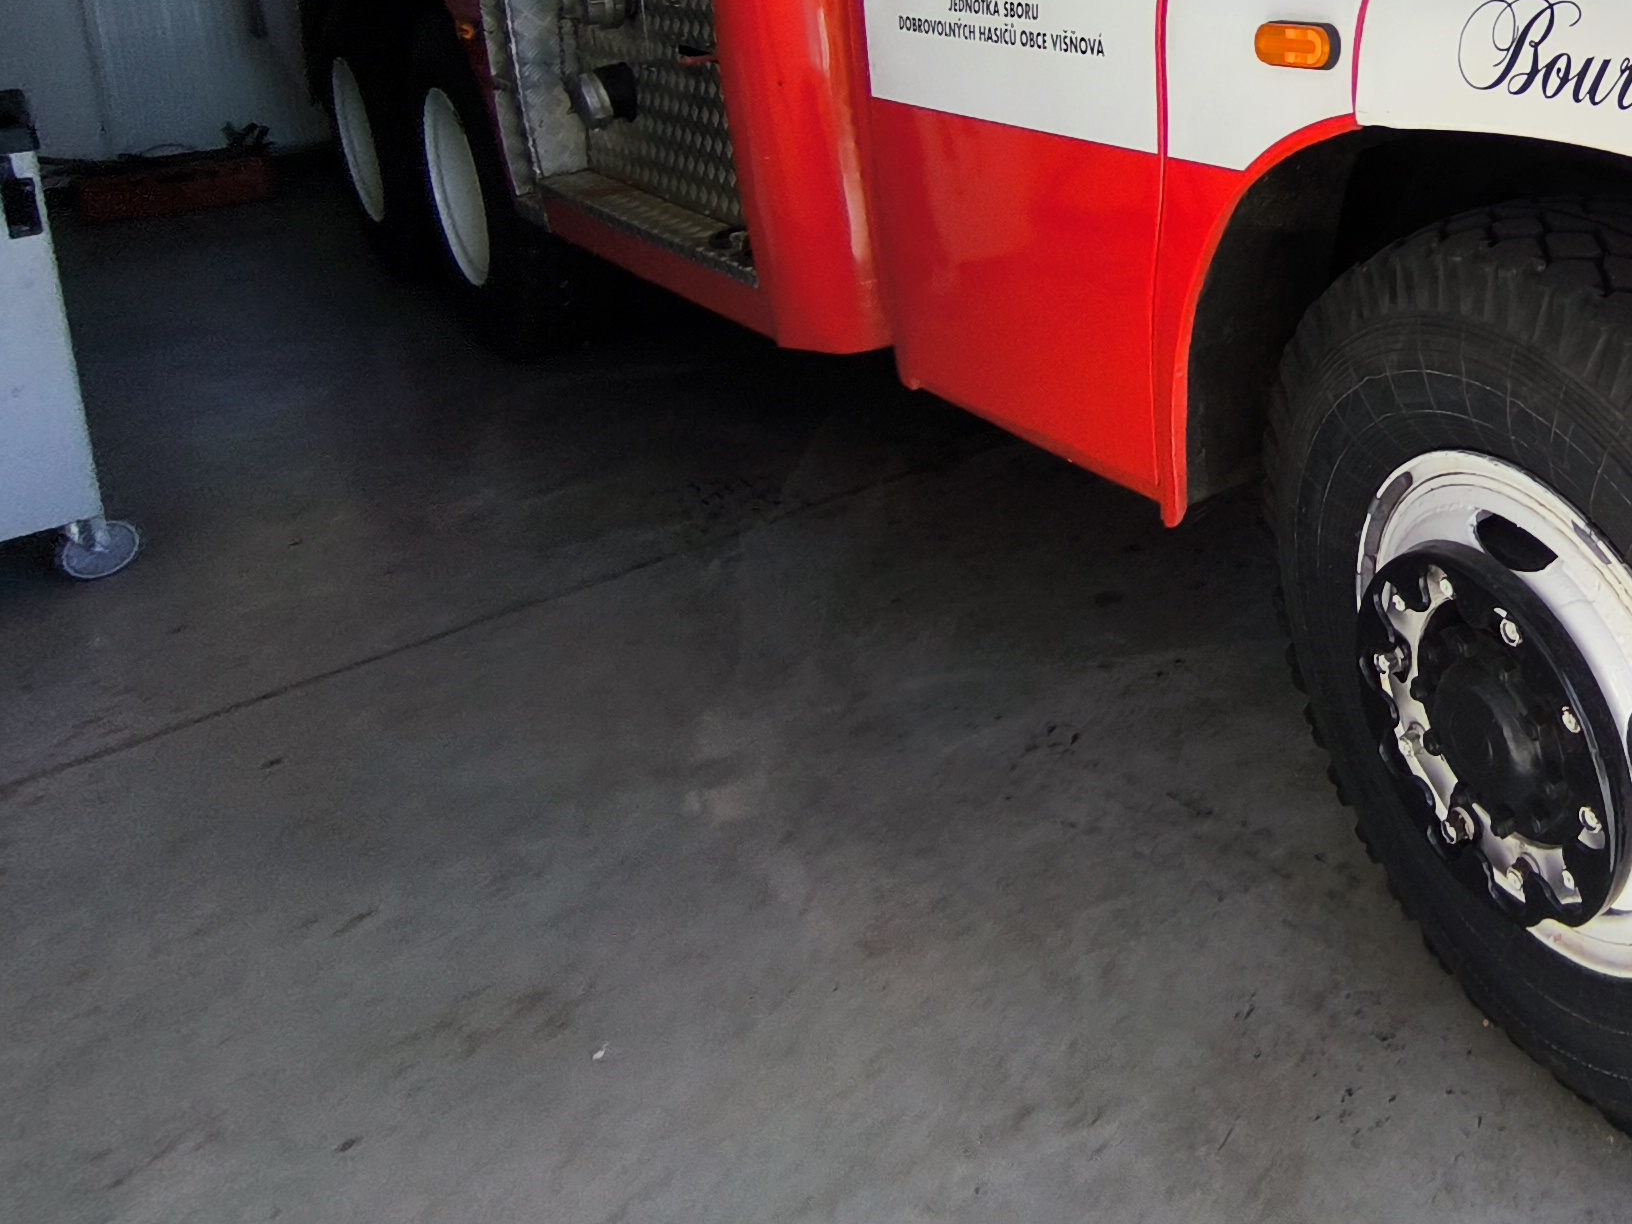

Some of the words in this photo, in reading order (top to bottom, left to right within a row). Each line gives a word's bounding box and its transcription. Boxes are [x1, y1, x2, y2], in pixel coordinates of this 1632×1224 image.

[1003, 1, 1039, 21] SBORU
[898, 16, 976, 41] DOBROVOLNÝCH
[979, 23, 1017, 45] HASIČŮ
[1019, 30, 1048, 50] OBCE
[1051, 30, 1105, 57] VIŠŇOVÁ
